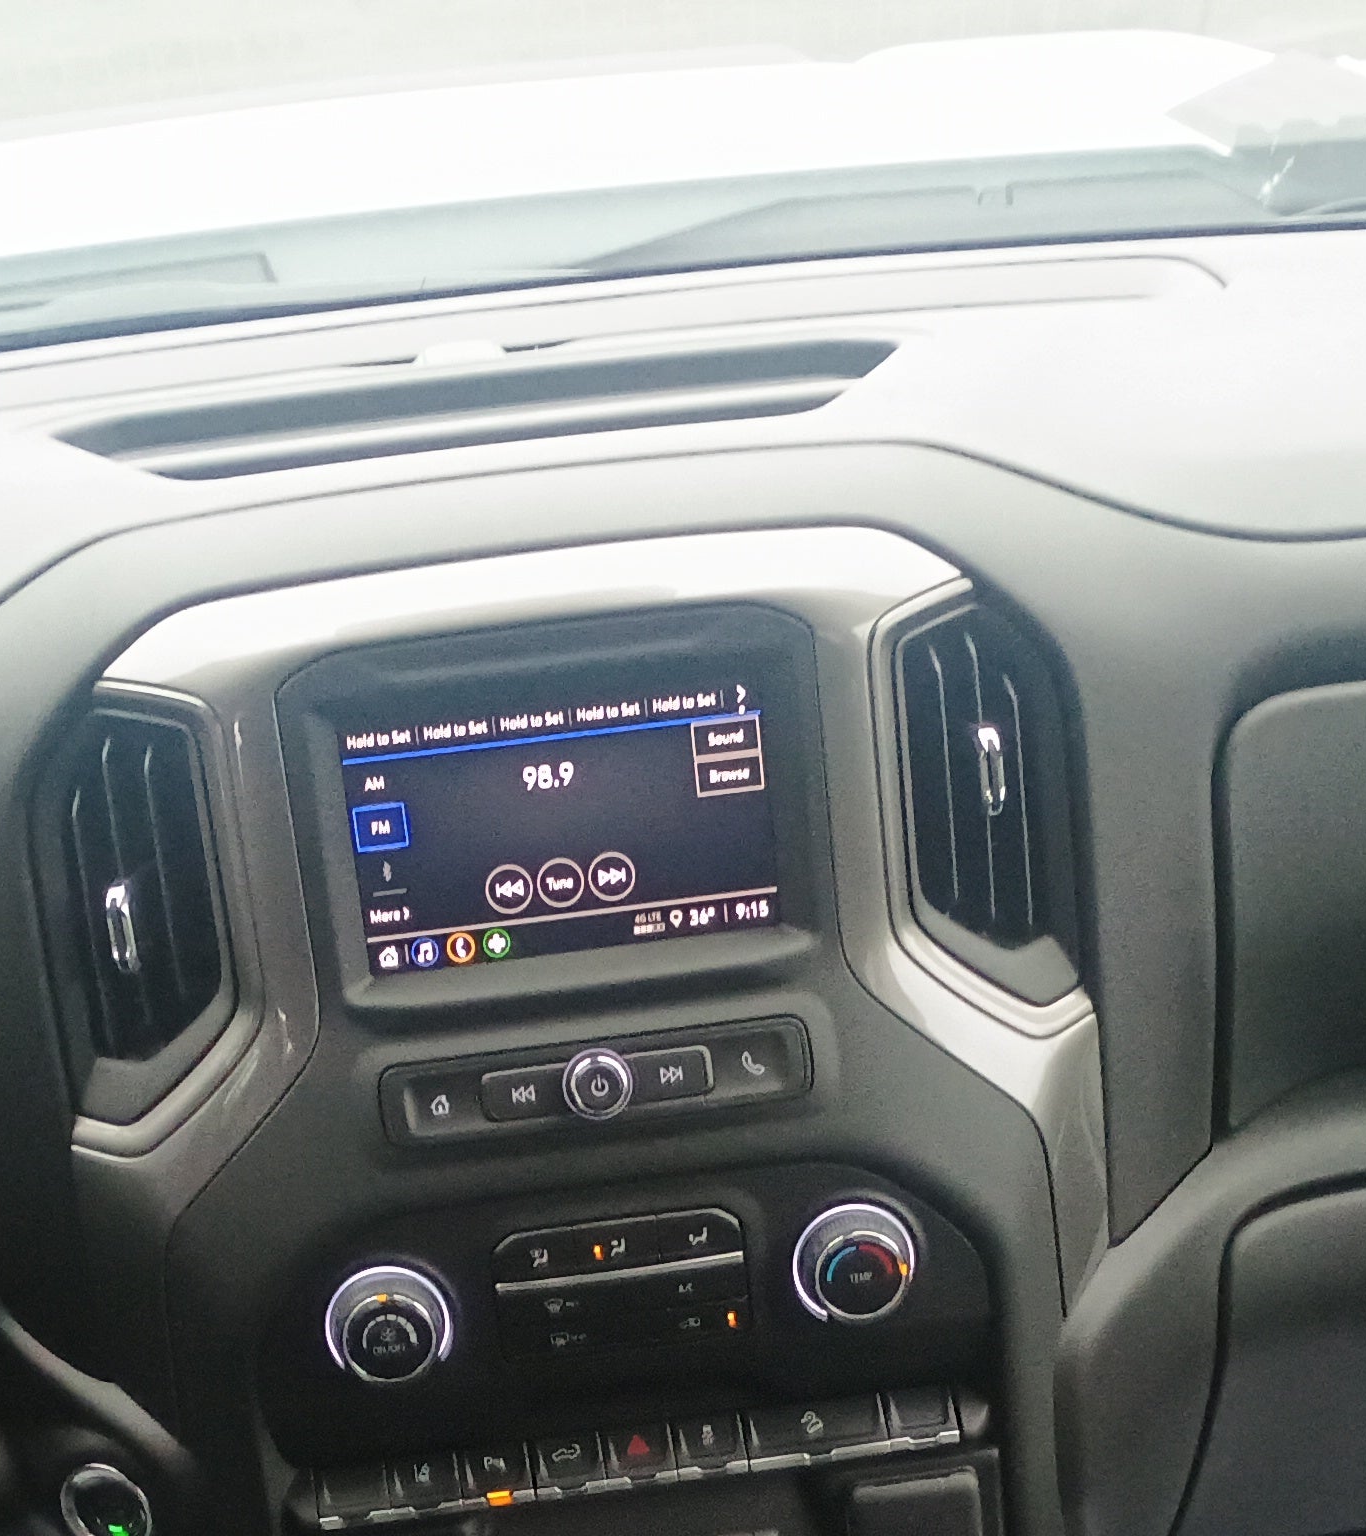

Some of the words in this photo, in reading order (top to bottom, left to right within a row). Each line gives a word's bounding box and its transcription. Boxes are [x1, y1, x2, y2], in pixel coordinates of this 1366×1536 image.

[576, 705, 604, 722] Hold
[606, 705, 619, 718] to
[621, 702, 640, 717] Set
[652, 696, 680, 713] Hold
[682, 696, 695, 710] to
[697, 692, 716, 707] Set
[423, 724, 451, 740] Hold
[454, 724, 466, 737] to
[469, 720, 488, 735] Set
[500, 714, 528, 731] Hold
[530, 714, 542, 728] to
[545, 711, 564, 725] Set
[346, 733, 374, 749] Hold
[377, 732, 390, 746] to
[392, 729, 411, 744] Set
[708, 729, 744, 747] Sound
[364, 776, 385, 792] AM
[522, 761, 574, 791] 98.9
[709, 768, 750, 784] Browse
[371, 820, 391, 836] FM
[546, 877, 574, 892] Tune
[370, 910, 401, 924] More
[735, 900, 769, 920] 9:15
